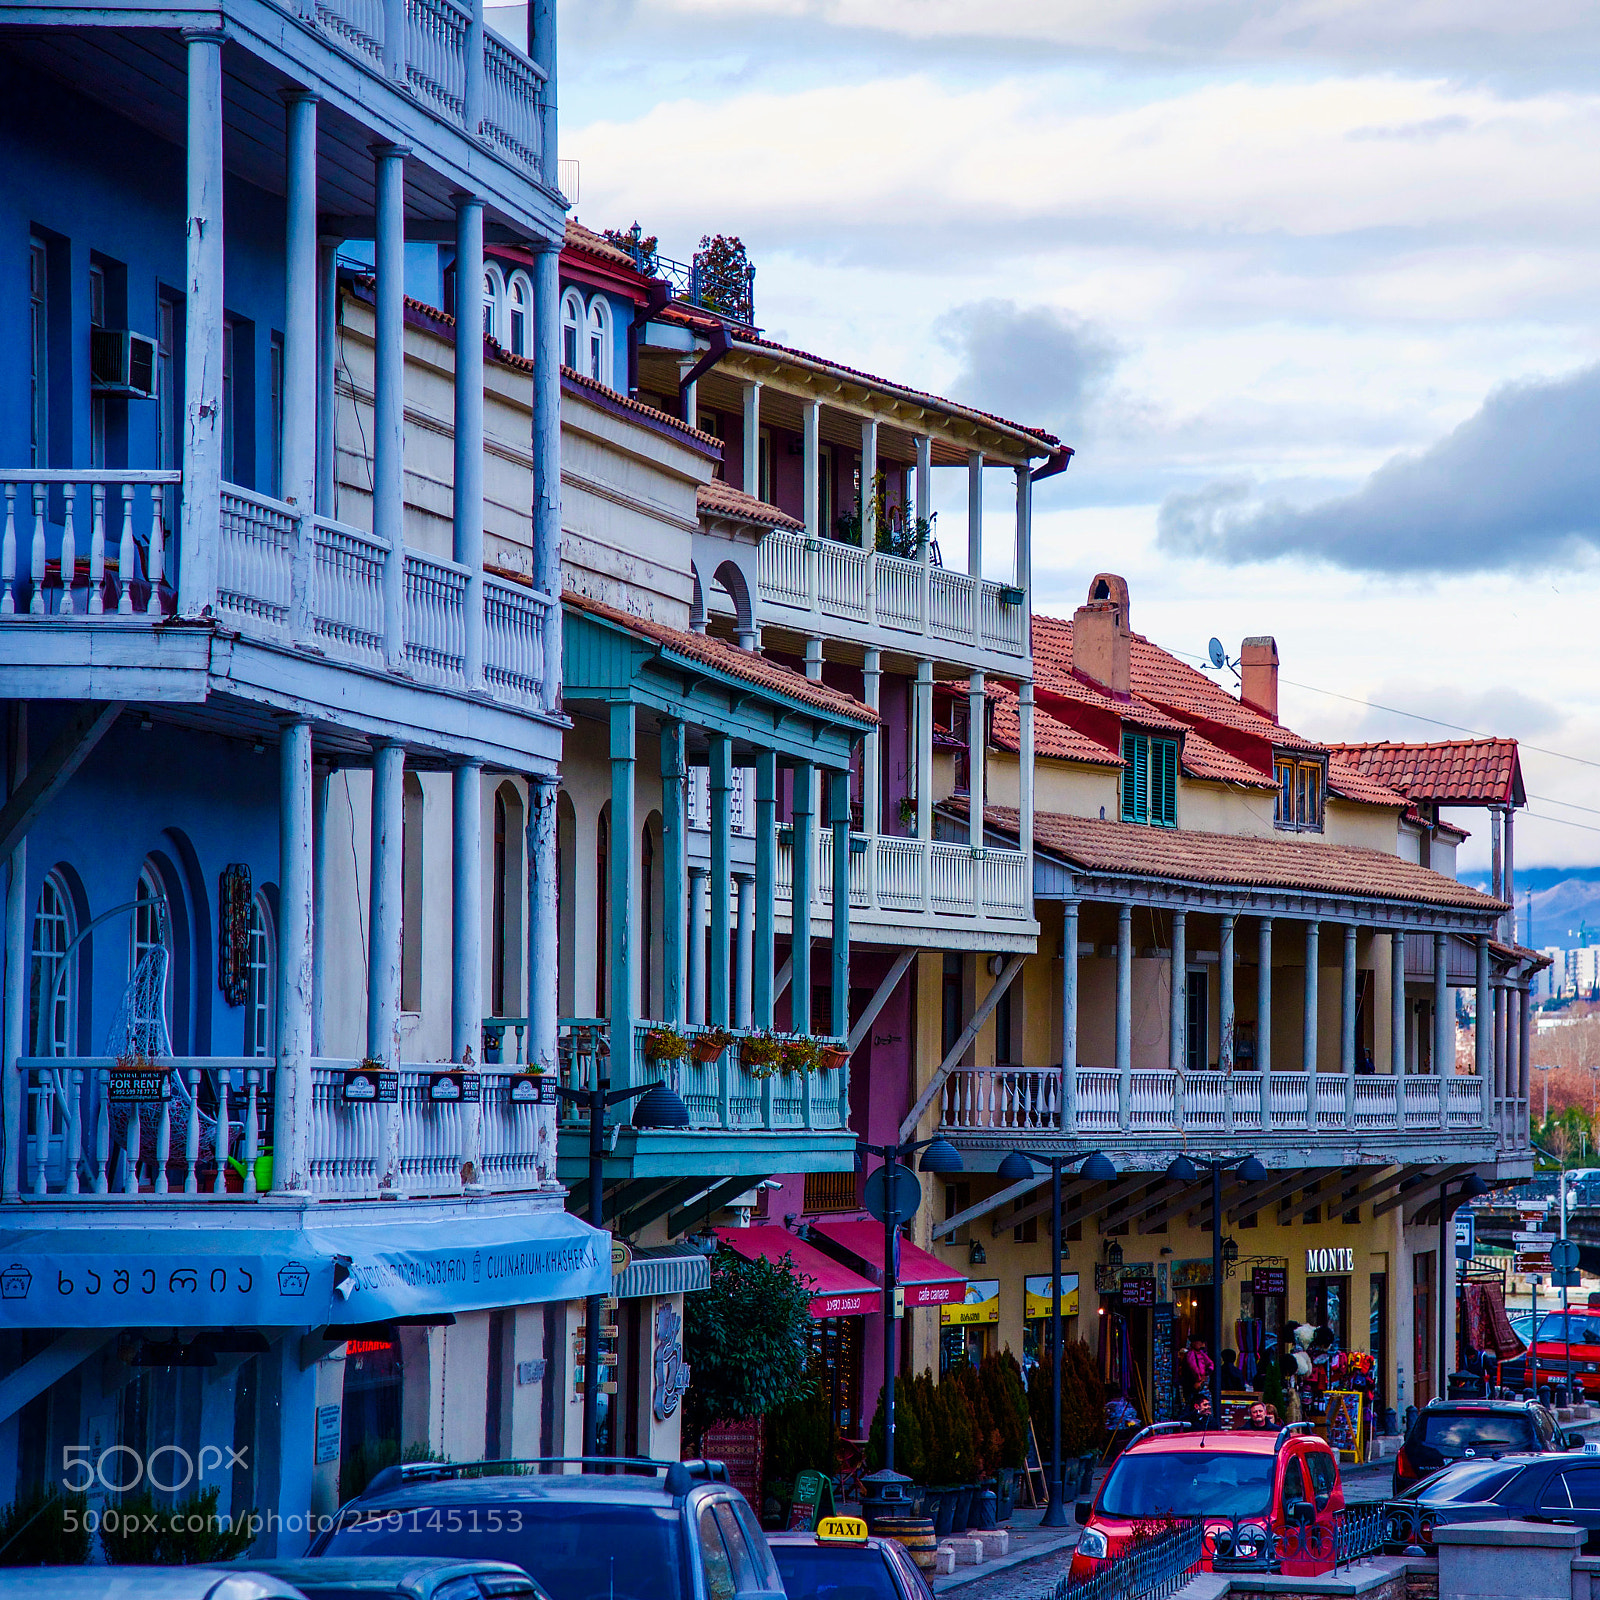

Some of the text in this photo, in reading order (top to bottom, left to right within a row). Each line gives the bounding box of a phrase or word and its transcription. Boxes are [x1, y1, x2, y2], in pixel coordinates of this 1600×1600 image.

[110, 1080, 161, 1089] FOR RENT
[487, 1247, 600, 1279] CULINARIUM-KHASHERIA
[1306, 1248, 1354, 1273] MONTE
[57, 1268, 253, 1295] ხაშერია
[918, 1286, 930, 1301] cafe
[825, 1522, 862, 1536] TAXI
